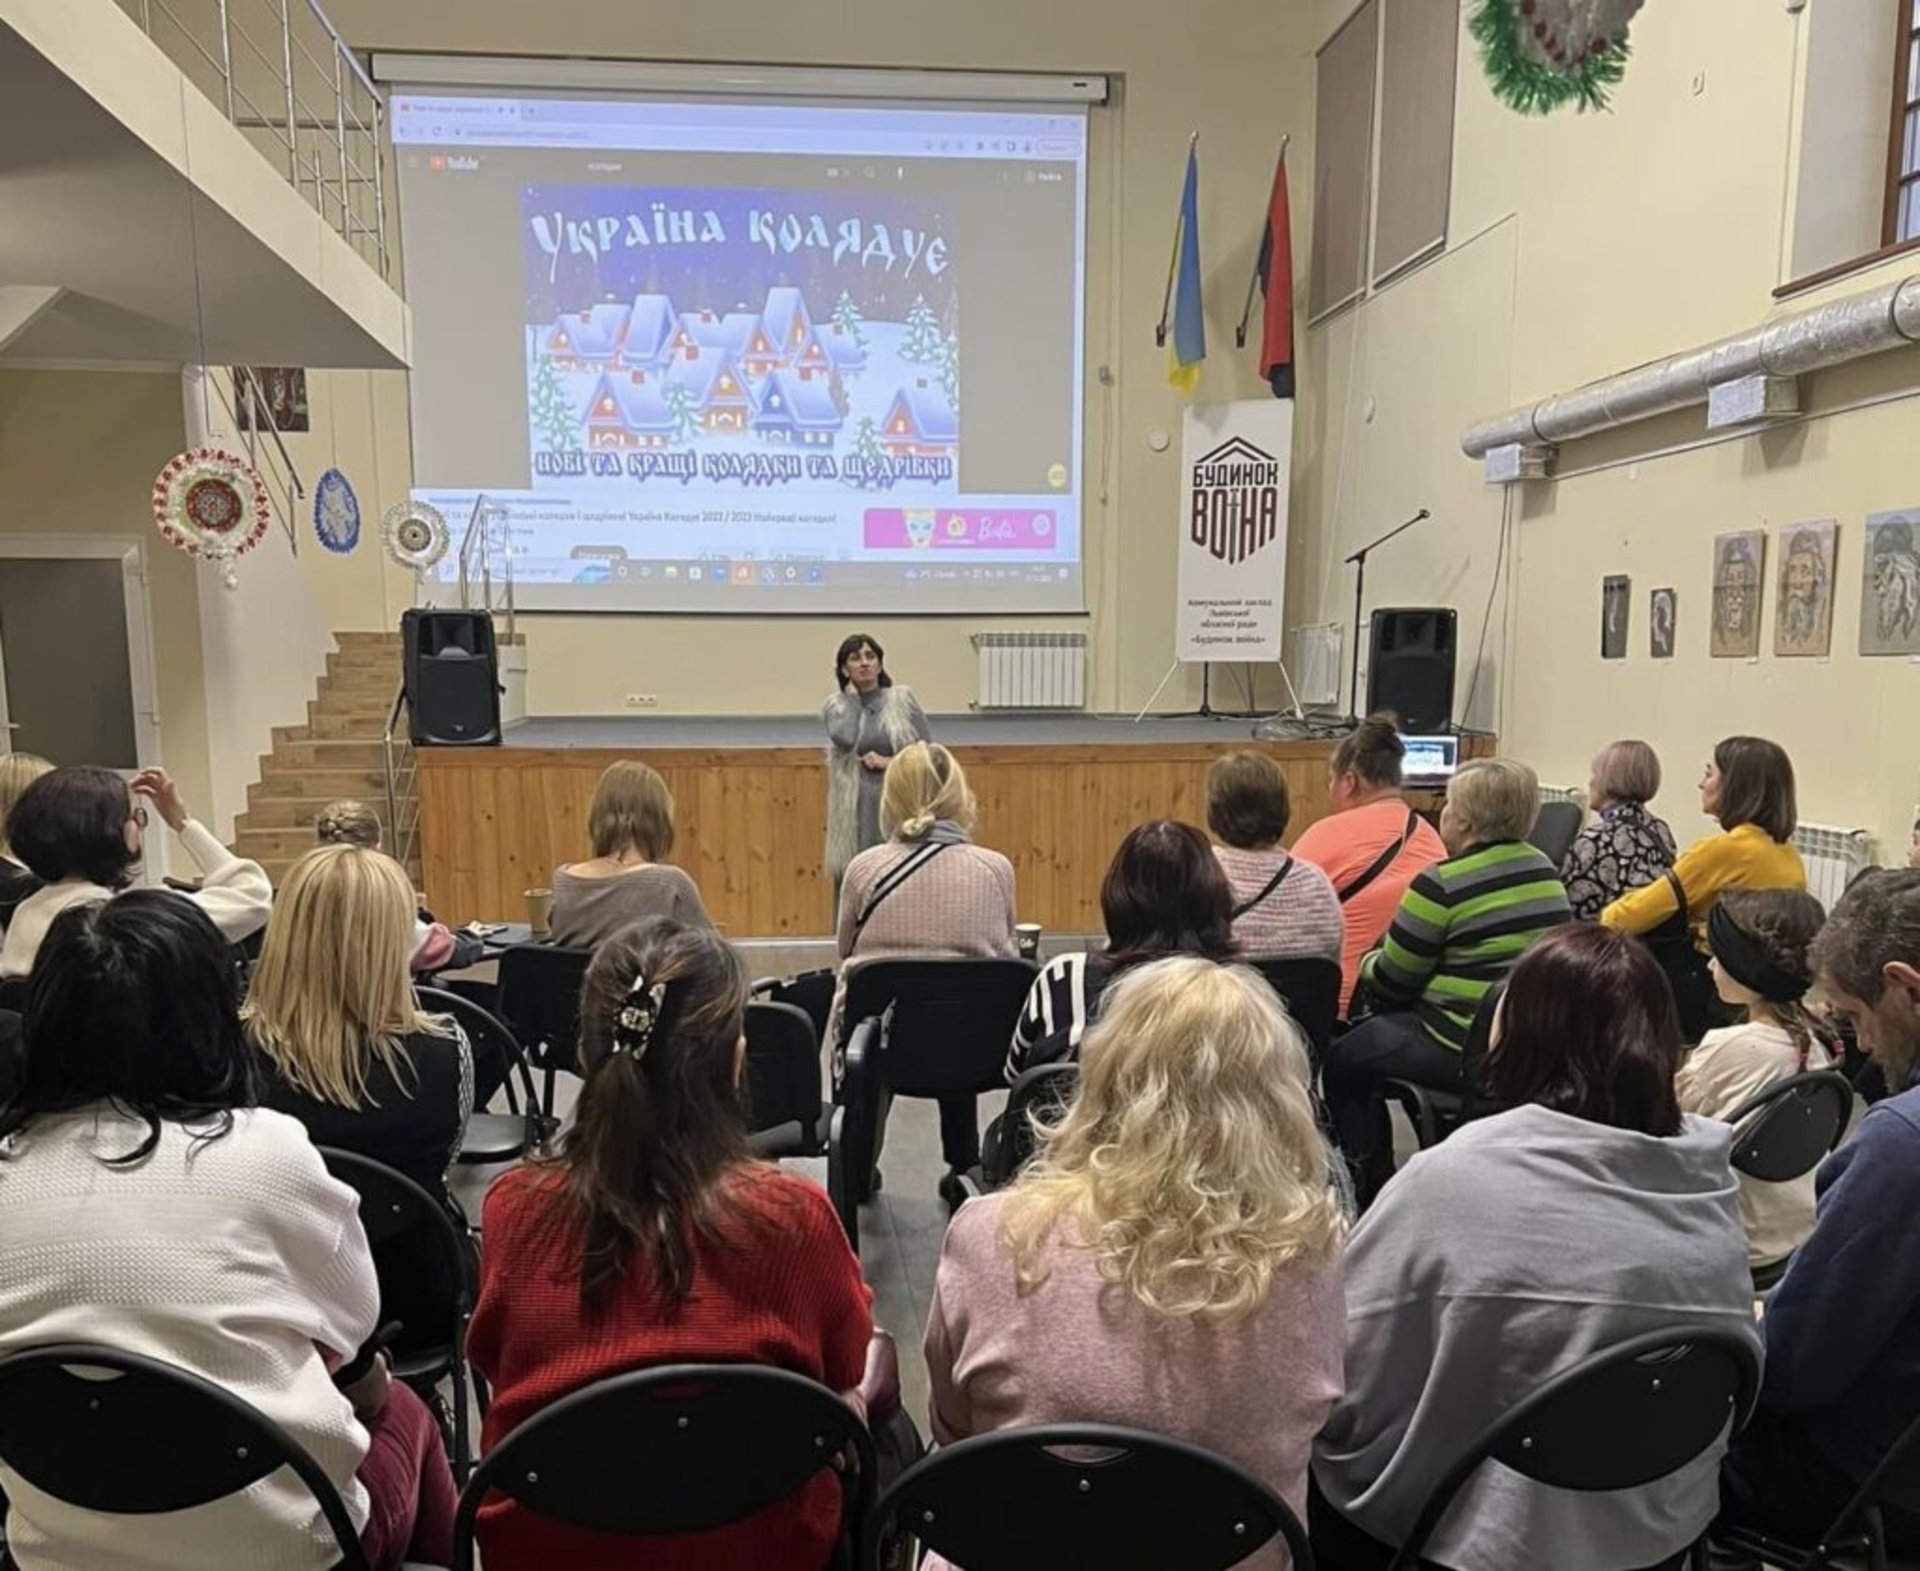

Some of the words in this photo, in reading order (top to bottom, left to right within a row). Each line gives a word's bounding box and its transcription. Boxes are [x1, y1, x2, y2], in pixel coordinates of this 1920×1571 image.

[531, 203, 726, 284] УКРАЇНА
[749, 210, 948, 278] КОЛЯДУЄ
[536, 450, 587, 478] НОВІ
[591, 452, 622, 477] ТА
[628, 451, 697, 485] КРАЩІ
[702, 452, 801, 486] КОЛЯДКИ
[806, 454, 837, 479] ТА
[1192, 462, 1279, 488] БУДИНОК
[1191, 486, 1278, 565] ВОЇНА
